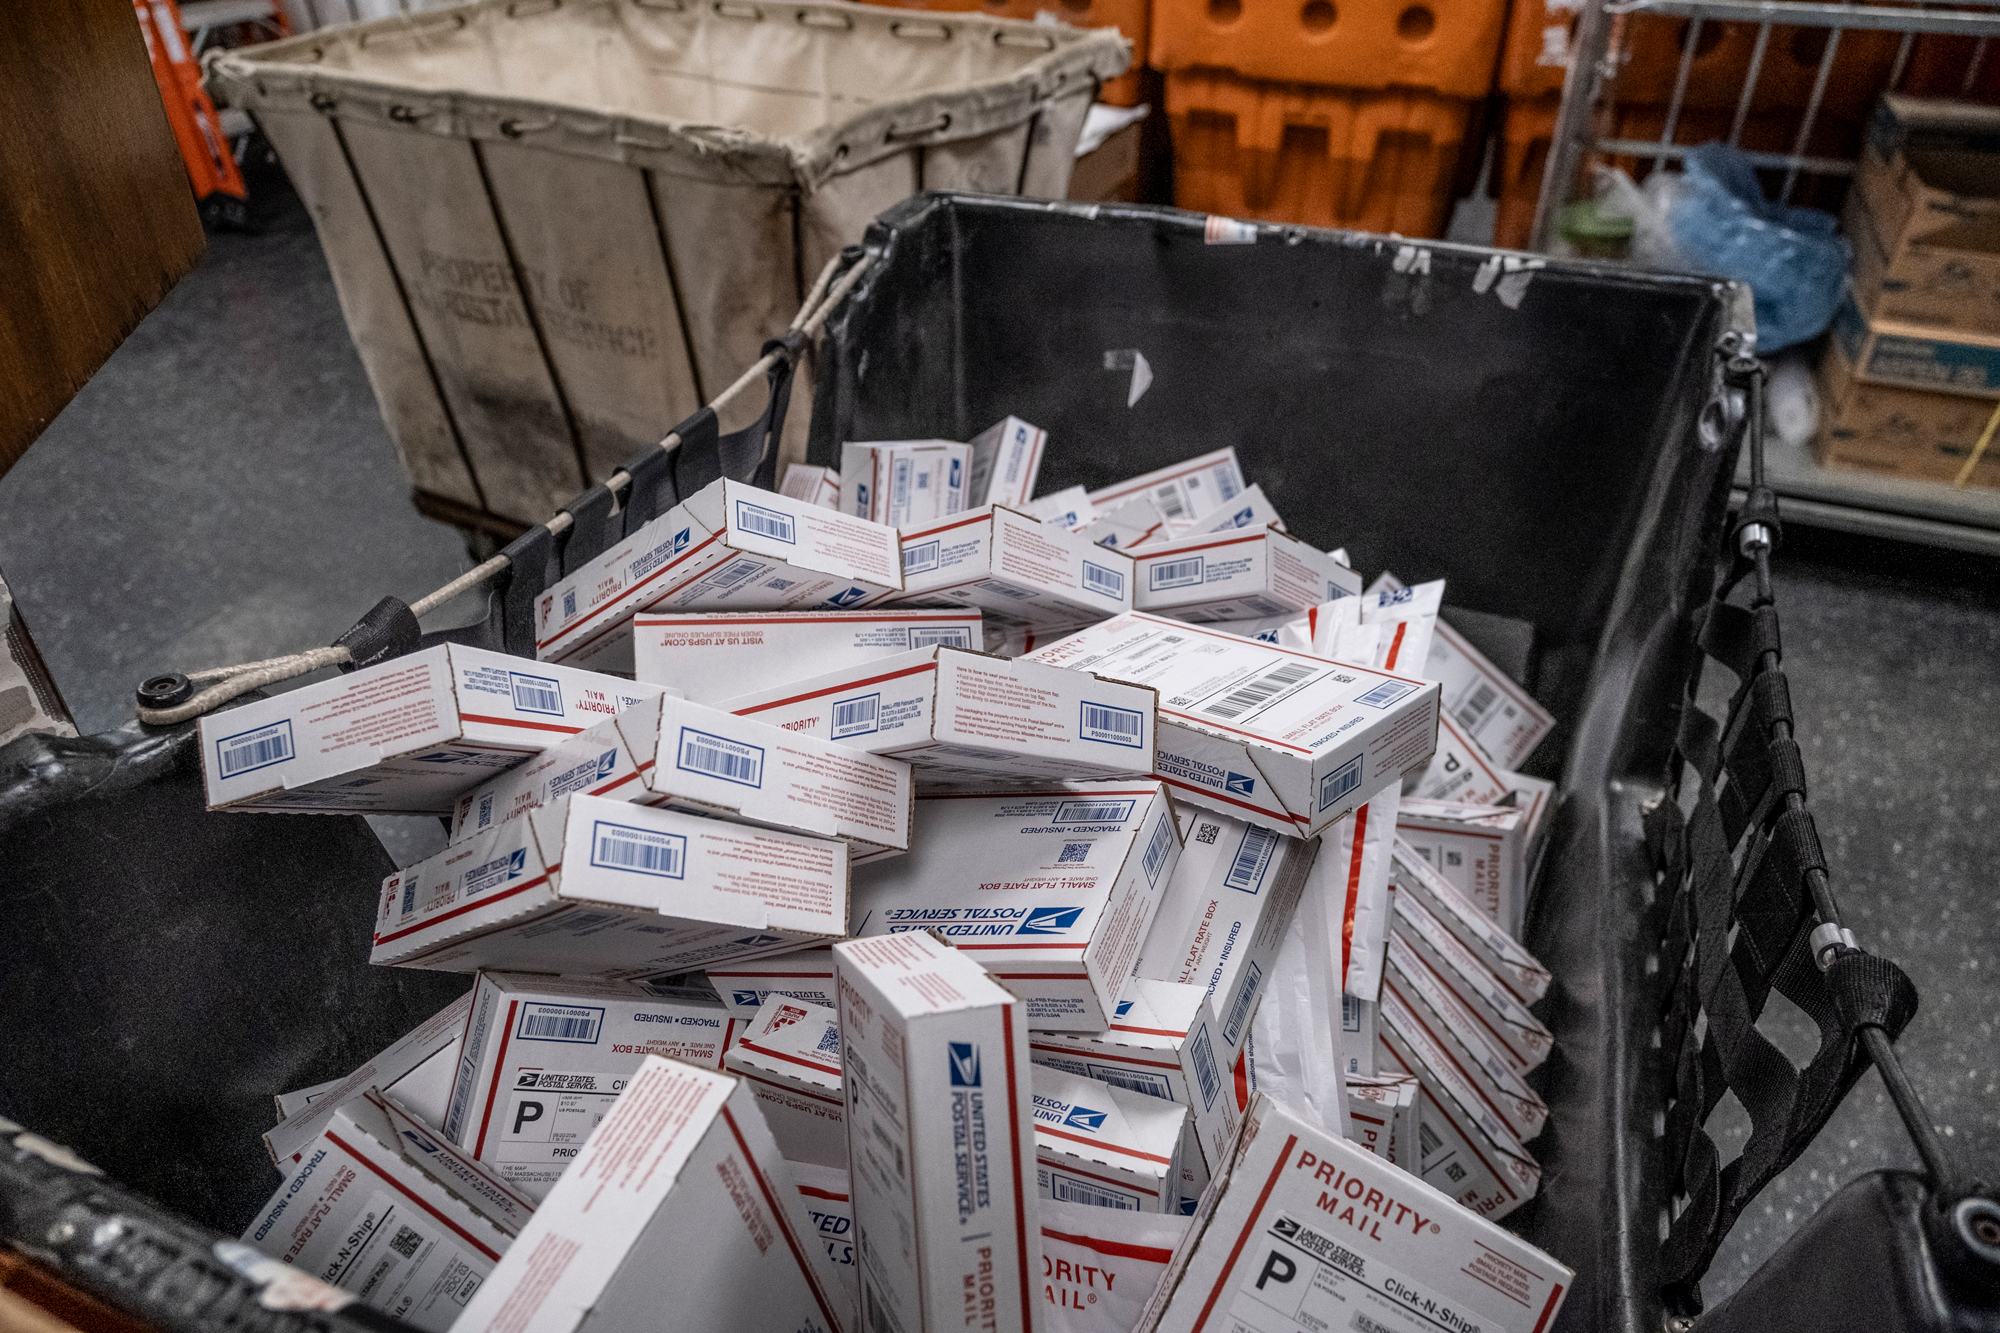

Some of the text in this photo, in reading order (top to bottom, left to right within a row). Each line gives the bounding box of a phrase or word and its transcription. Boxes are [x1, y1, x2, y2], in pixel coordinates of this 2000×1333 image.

[651, 538, 676, 556] POSTAL
[633, 550, 675, 580] UNITED STATES
[597, 577, 614, 590] MAIL
[727, 637, 739, 645] US
[742, 637, 763, 645] VISIT
[1046, 648, 1084, 664] MAIL
[585, 689, 604, 700] MAIL
[1282, 704, 1344, 741] SMALL FLAT RATE BOX
[1309, 716, 1364, 748] TRACKED INSURED
[1091, 730, 1132, 743] PS00011000003
[1157, 762, 1223, 788] UNITED STATES
[1191, 760, 1225, 777] POSTAL
[514, 791, 531, 805] MAIL
[1020, 826, 1066, 834] INSURED
[435, 882, 450, 892] MAIL
[1475, 858, 1485, 894] MAIL
[885, 908, 1027, 920] POSTAL SERVICE®
[947, 924, 1014, 935] UNITED
[1184, 900, 1218, 968] FLAT RATE BOX
[1220, 921, 1242, 960] INSURED
[1195, 932, 1212, 966] ANY WEIGHT
[634, 1013, 720, 1028] TRACKED INSURED
[612, 1044, 714, 1058] SMALL BOX
[537, 1079, 565, 1089] POSTAL
[540, 1074, 595, 1083] UNITED STATES
[759, 1087, 785, 1099] ONLINE
[786, 1096, 820, 1110] SUPPLIES
[513, 1101, 544, 1134] P
[828, 1113, 842, 1122] US
[952, 1092, 967, 1150] POSTAL
[970, 1092, 990, 1208] UNITED STATES
[432, 1155, 468, 1182] POSTAL
[254, 1150, 327, 1242] TRACKED INSURED
[1296, 1150, 1440, 1235] PRIORITY®
[289, 1170, 356, 1255] SMALL FLAT RATE
[1316, 1192, 1382, 1242] MAIL
[1295, 1234, 1328, 1257] POSTAL
[1299, 1228, 1365, 1268] UNITED STATES
[443, 1264, 469, 1296] RDC 03
[1255, 1250, 1296, 1291] P
[1476, 1258, 1530, 1291] SMALL FLAT RATE
[1484, 1253, 1527, 1281] PRIORITY MAIL
[460, 1280, 475, 1298] R022
[1469, 1263, 1530, 1301] POSTAGE REQUIRED
[963, 1274, 977, 1326] MAIL
[1384, 1277, 1481, 1333] Click-N-Ship®
